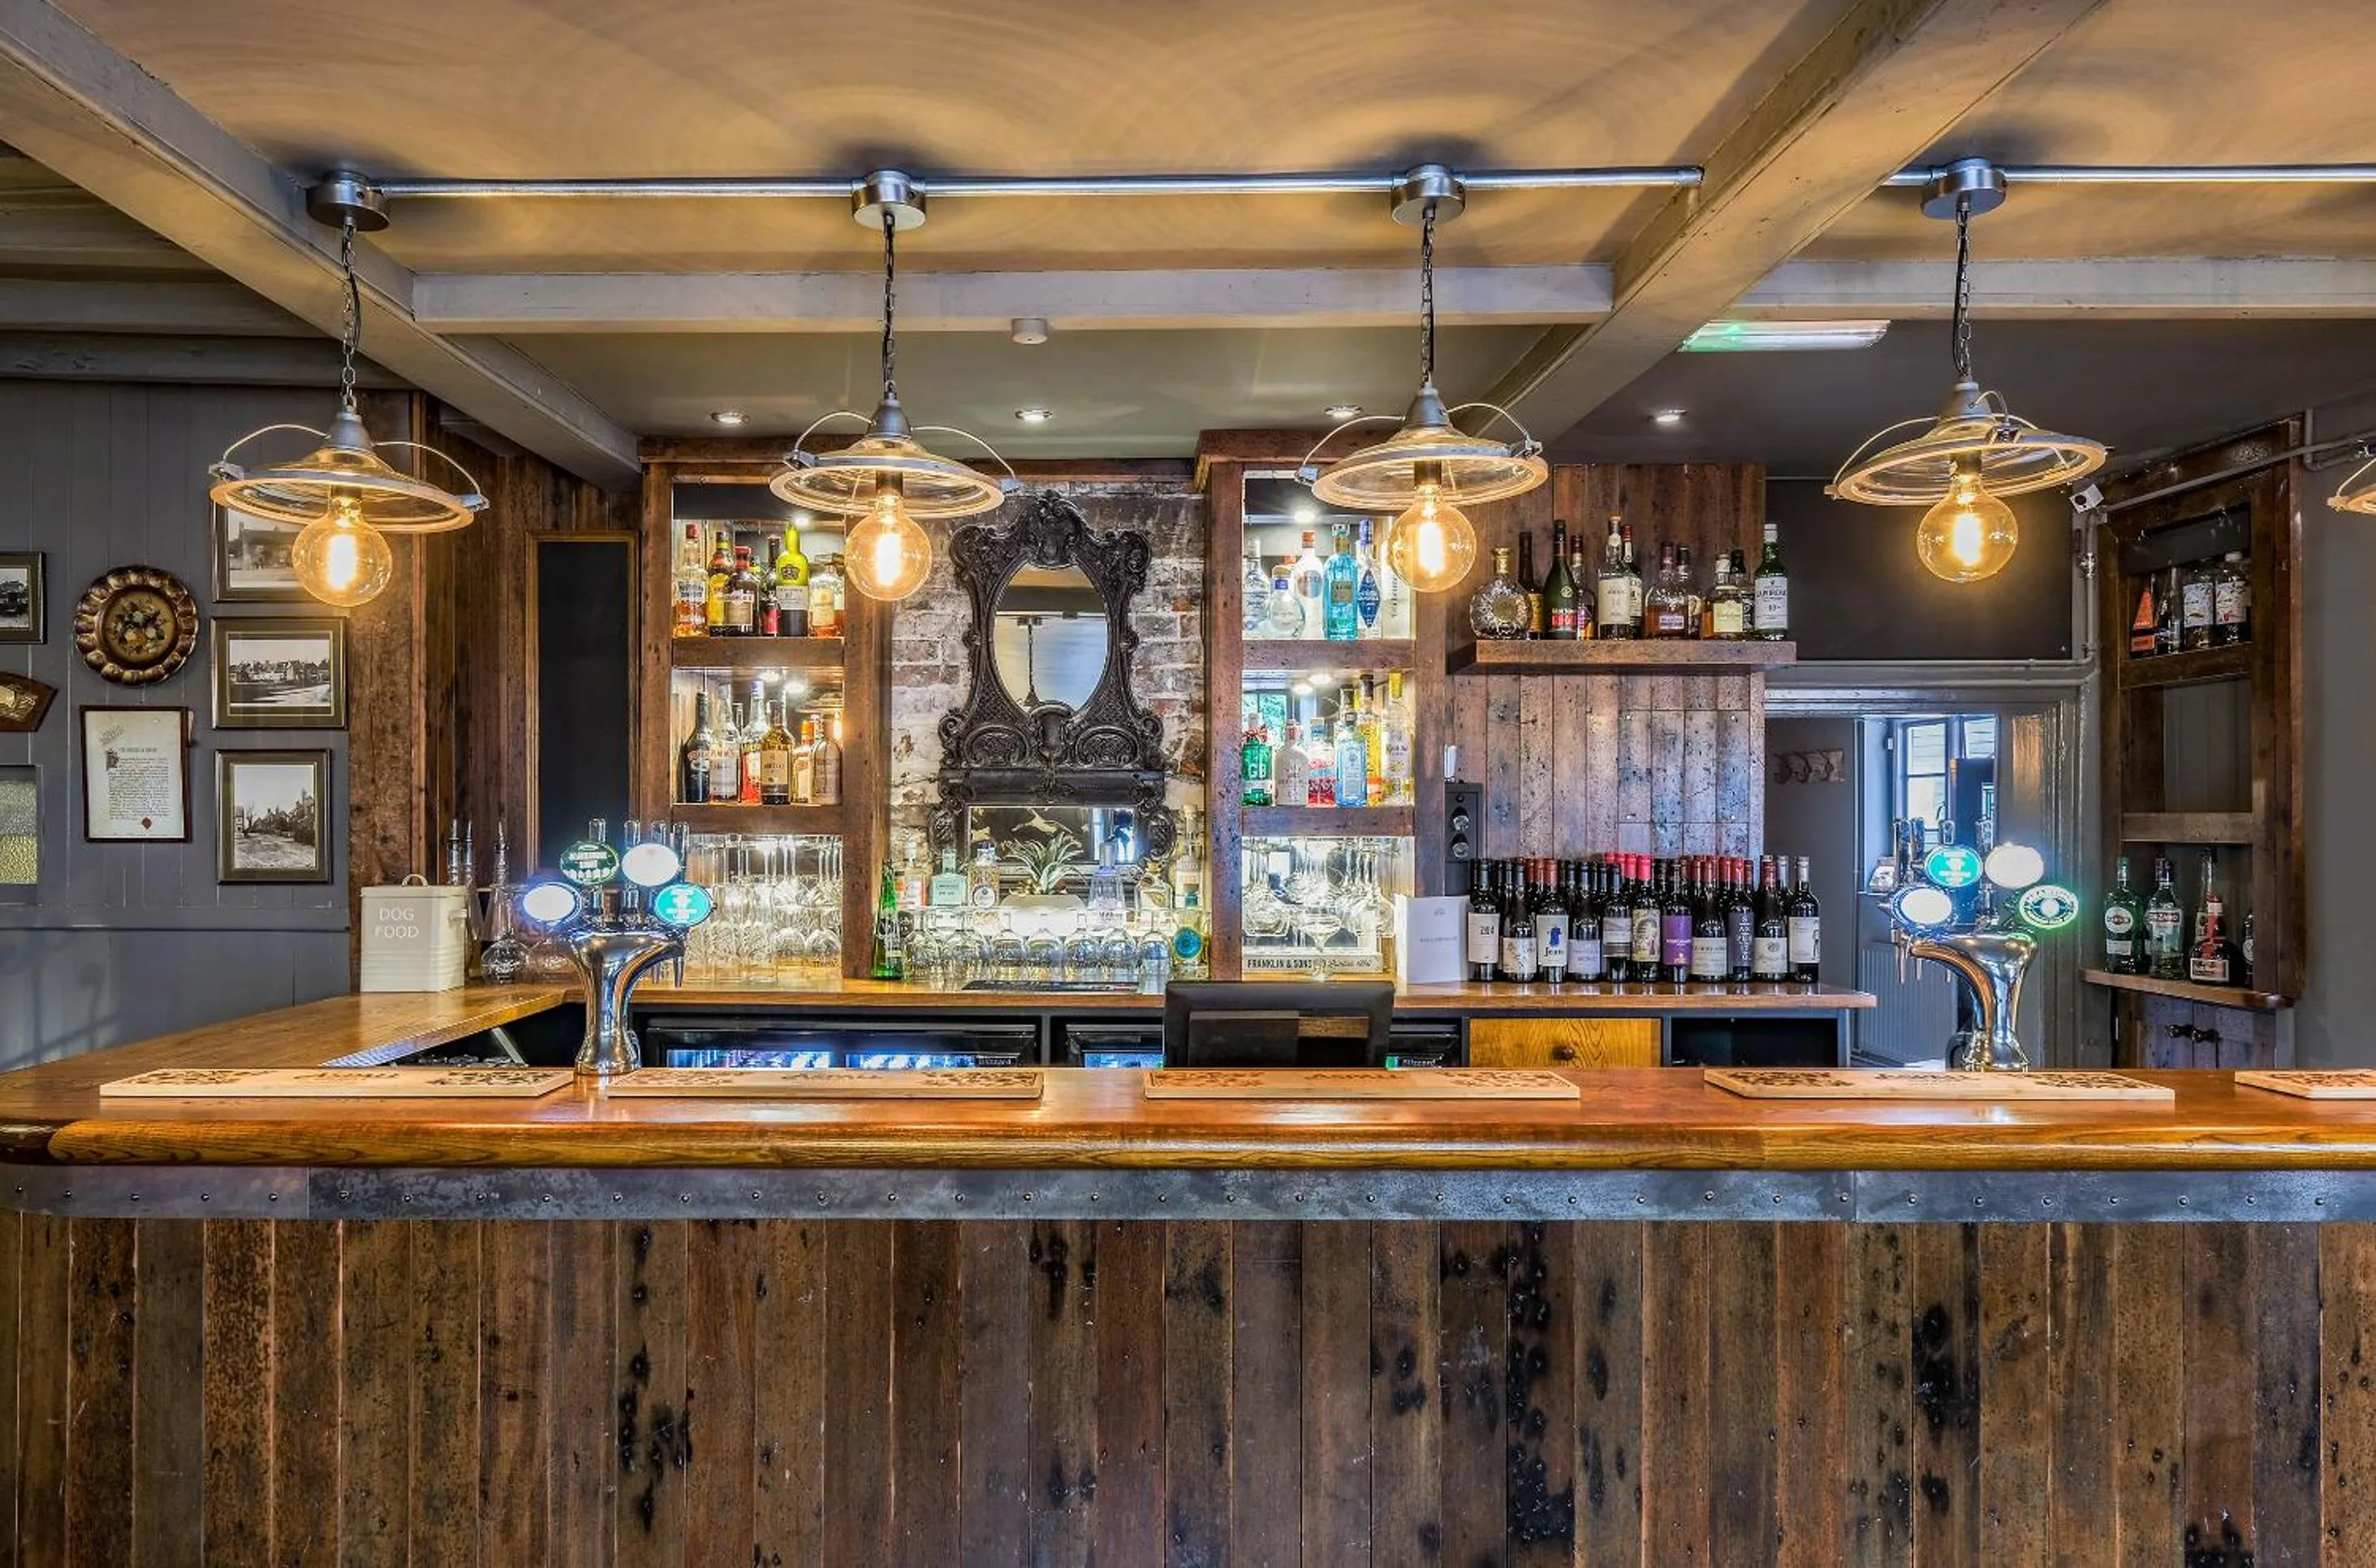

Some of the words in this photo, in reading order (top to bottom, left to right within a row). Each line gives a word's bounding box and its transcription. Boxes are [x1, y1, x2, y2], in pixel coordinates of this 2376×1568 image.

[379, 908, 414, 921] DOG
[375, 925, 420, 938] FOOD
[1247, 958, 1284, 969] FRANKLIN
[1286, 958, 1291, 968] &
[1293, 958, 1313, 969] SONS
